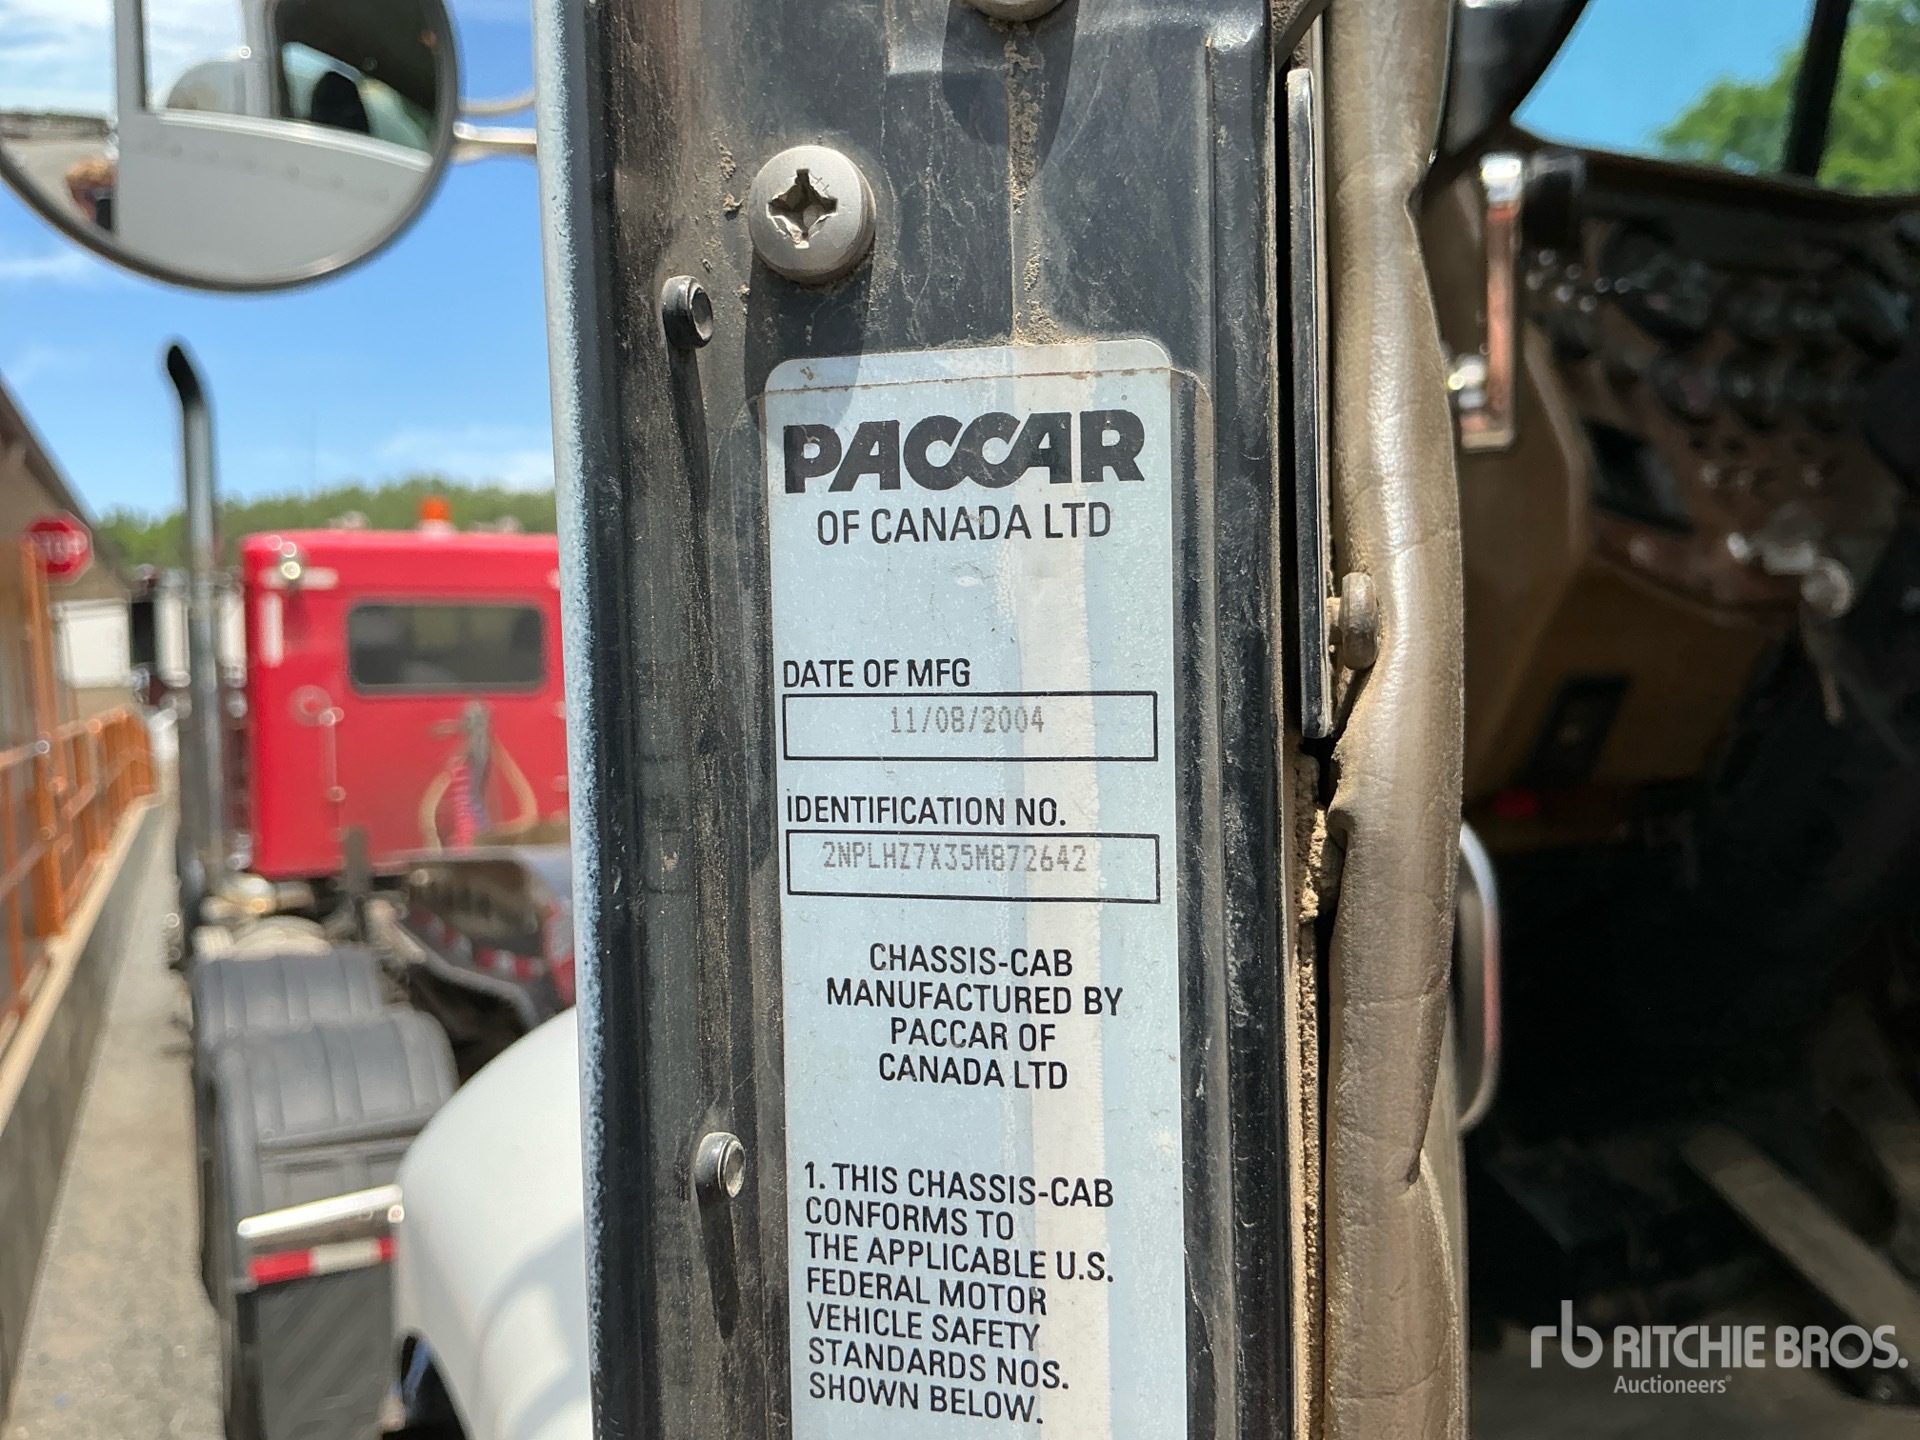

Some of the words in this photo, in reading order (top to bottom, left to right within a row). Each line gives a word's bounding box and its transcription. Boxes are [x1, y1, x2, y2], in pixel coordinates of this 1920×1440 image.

[784, 409, 1145, 494] PACCAR
[817, 510, 859, 545] OF
[871, 505, 1032, 543] CANADA
[1044, 502, 1111, 538] LTD
[783, 660, 853, 687] DATE
[864, 659, 898, 687] OF
[907, 658, 971, 686] MFG
[890, 706, 1044, 733] 11/08/2004
[786, 796, 1005, 824] IDENTIFICATION
[1015, 799, 1066, 826] NO.
[822, 842, 1088, 872] 2NPLHZ7X35M872642
[869, 943, 1072, 976] CHASSIS-CAB
[826, 978, 1072, 1013] MANUFACTURED
[1084, 987, 1124, 1016] BY
[890, 1017, 1008, 1050] PACCAR
[1019, 1023, 1056, 1051] OF
[878, 1053, 1005, 1087] CANADA
[1014, 1061, 1068, 1089] LTD
[804, 1162, 824, 1190] 1.
[832, 1163, 897, 1194] THIS
[908, 1168, 1113, 1207] CHASSIS-CAB
[805, 1198, 968, 1237] CONFORMS
[976, 1211, 1013, 1240] TO
[805, 1233, 858, 1263] THE
[866, 1237, 1045, 1279] APPLICABLE
[1056, 1251, 1114, 1282] U.S.
[806, 1268, 930, 1304] FEDERAL
[939, 1281, 1047, 1315] MOTOR
[807, 1302, 921, 1339] VEHICLE
[931, 1314, 1040, 1351] SAFETY
[809, 1338, 986, 1381] STANDARDS
[996, 1358, 1069, 1390] NOS.
[810, 1372, 919, 1409] SHOWN
[929, 1390, 1043, 1425] BELOW.
